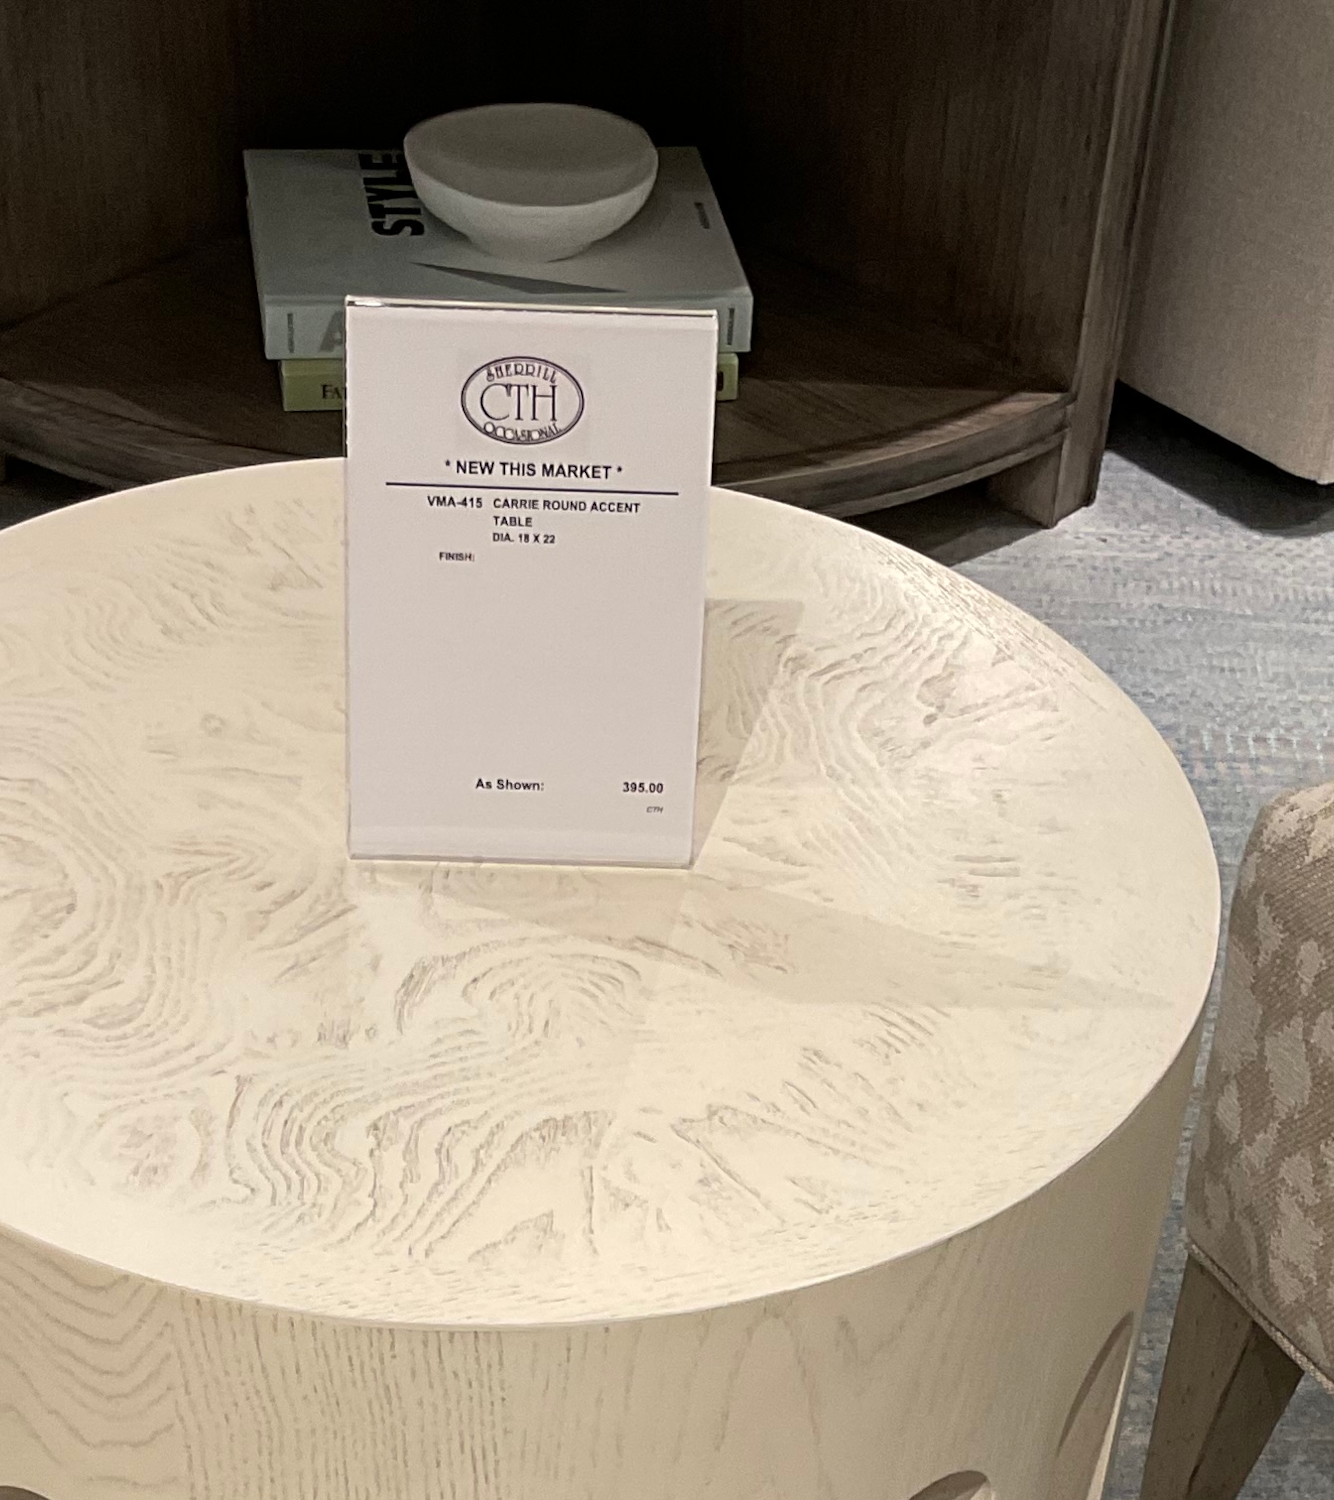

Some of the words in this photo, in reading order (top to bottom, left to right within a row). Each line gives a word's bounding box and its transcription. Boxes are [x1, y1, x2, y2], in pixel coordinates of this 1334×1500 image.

[358, 153, 425, 237] STYLE
[486, 362, 558, 383] SHERRILL
[479, 382, 558, 422] CTH
[455, 460, 495, 475] NEW
[499, 462, 537, 477] THIS
[541, 464, 612, 480] MARKET
[427, 495, 483, 509] VMA-415
[493, 497, 540, 510] CARRIE
[542, 499, 587, 512] ROUND
[590, 501, 641, 514] ACCENT
[493, 515, 533, 528] TABLE
[492, 532, 514, 543] DIA.
[518, 533, 530, 544] 18
[533, 534, 540, 544] X
[543, 534, 556, 544] 22
[475, 778, 493, 790] As
[496, 779, 545, 792] Shown:
[622, 781, 664, 794] 395.00
